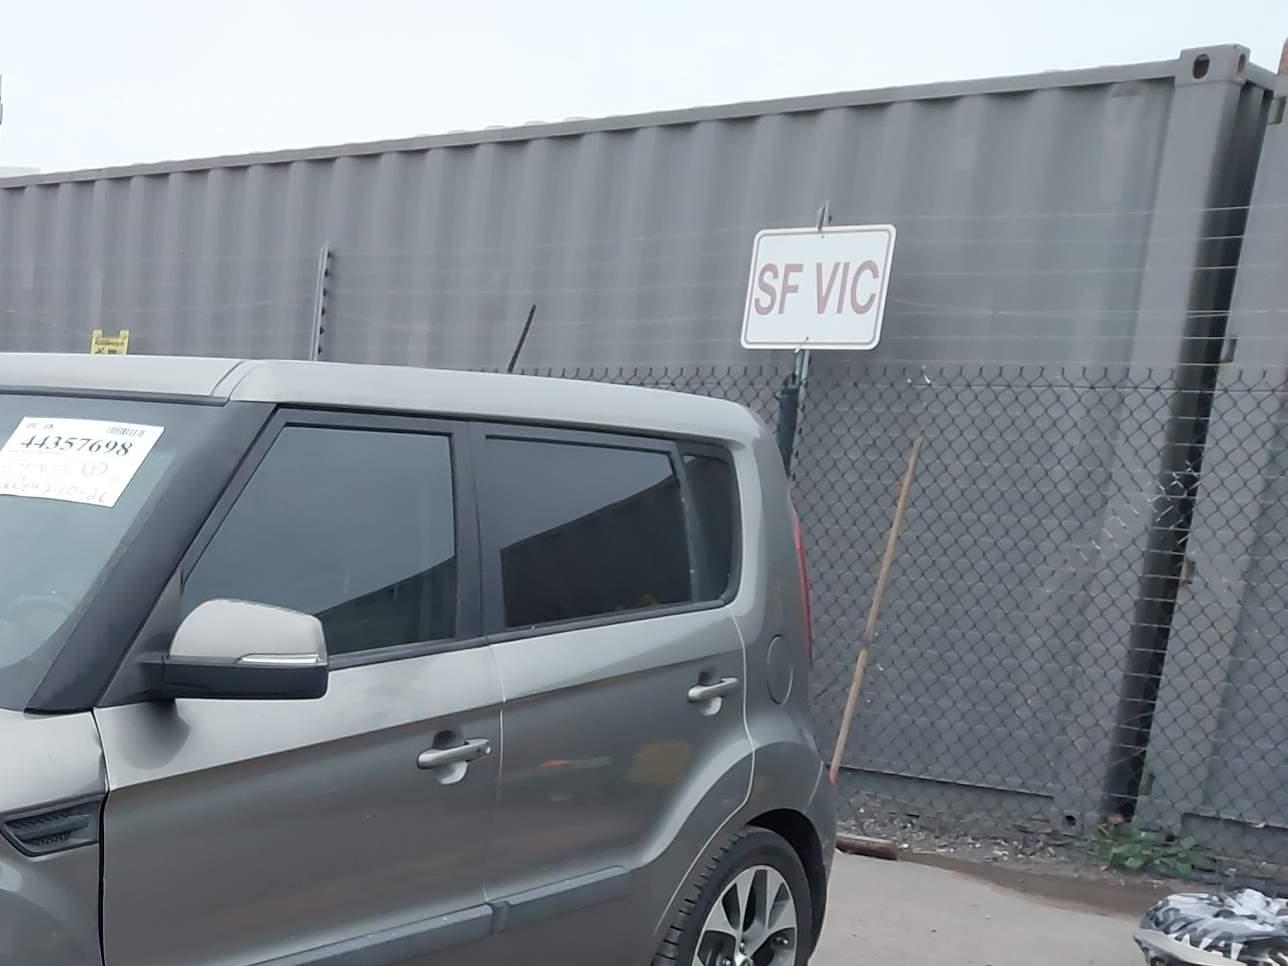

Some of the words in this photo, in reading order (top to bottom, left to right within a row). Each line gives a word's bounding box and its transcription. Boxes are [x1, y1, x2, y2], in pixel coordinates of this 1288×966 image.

[754, 262, 804, 315] SF
[816, 260, 880, 315] VIC
[20, 434, 133, 457] 44357698
